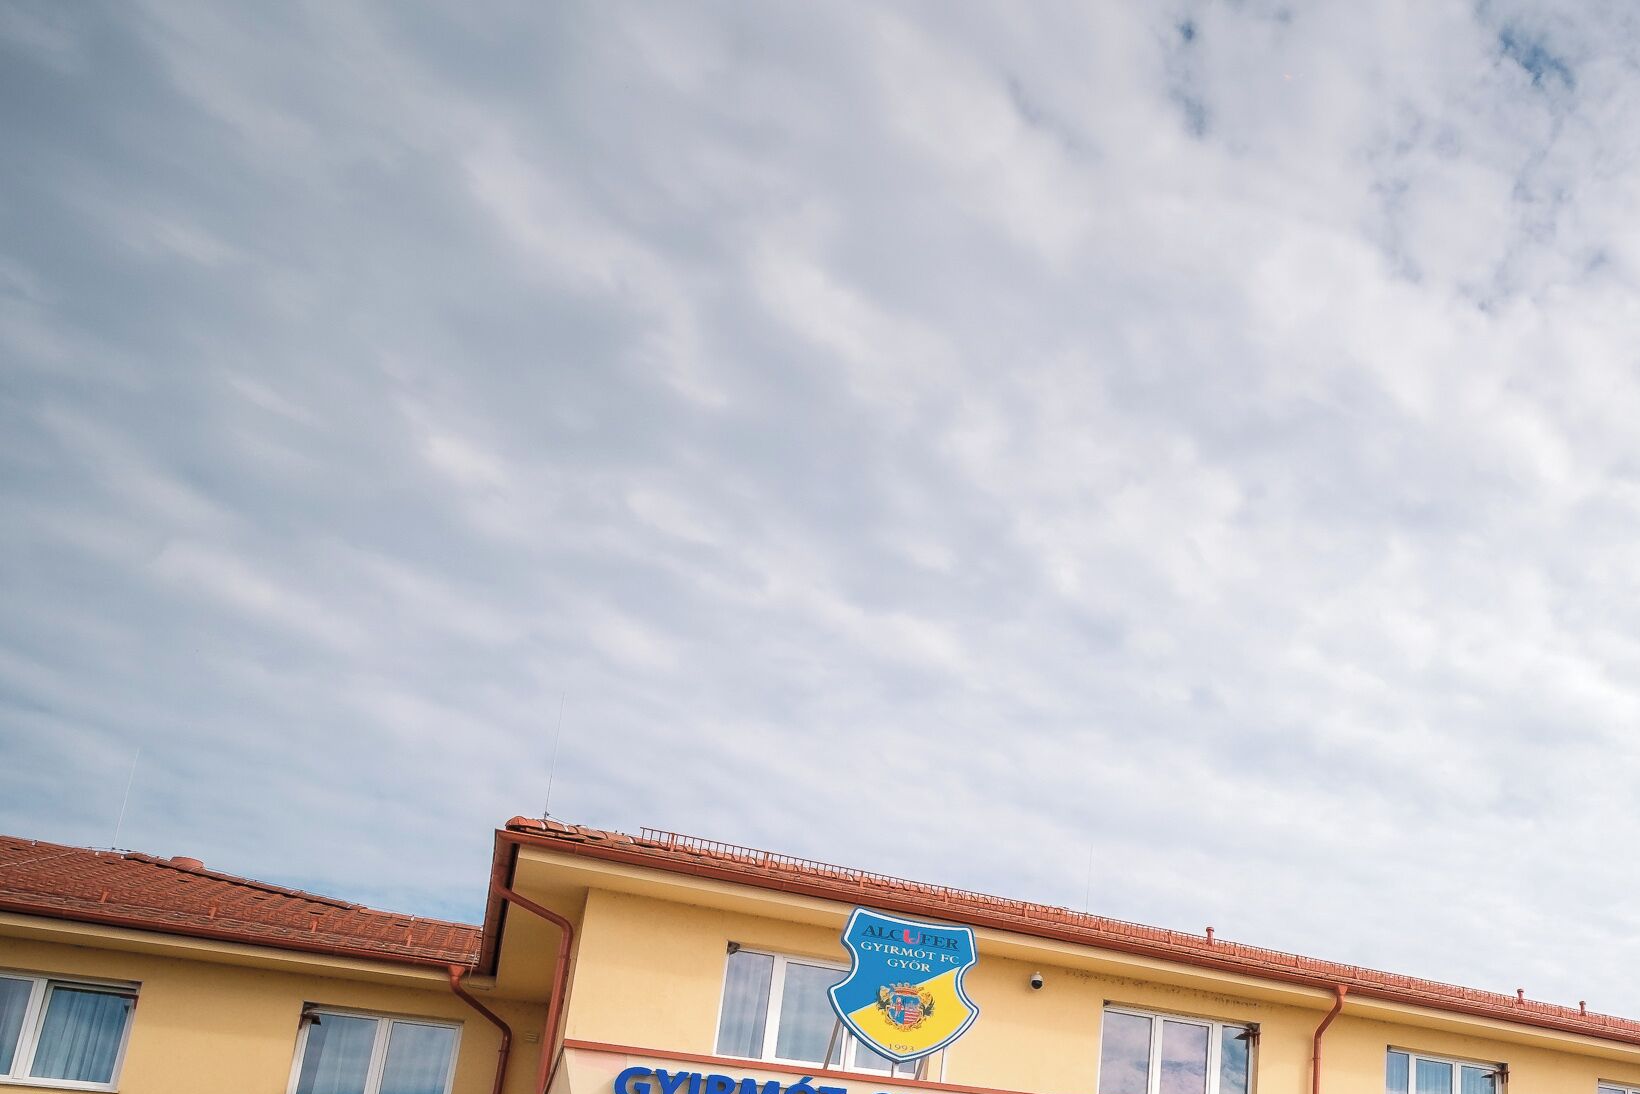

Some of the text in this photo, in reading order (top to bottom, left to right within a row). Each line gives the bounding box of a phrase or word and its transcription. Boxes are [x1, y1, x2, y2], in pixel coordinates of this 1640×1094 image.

[862, 925, 959, 950] ALCUFER
[861, 941, 960, 964] GYIRMÓT FC
[887, 958, 931, 972] GYŐR
[889, 1043, 915, 1053] 1993
